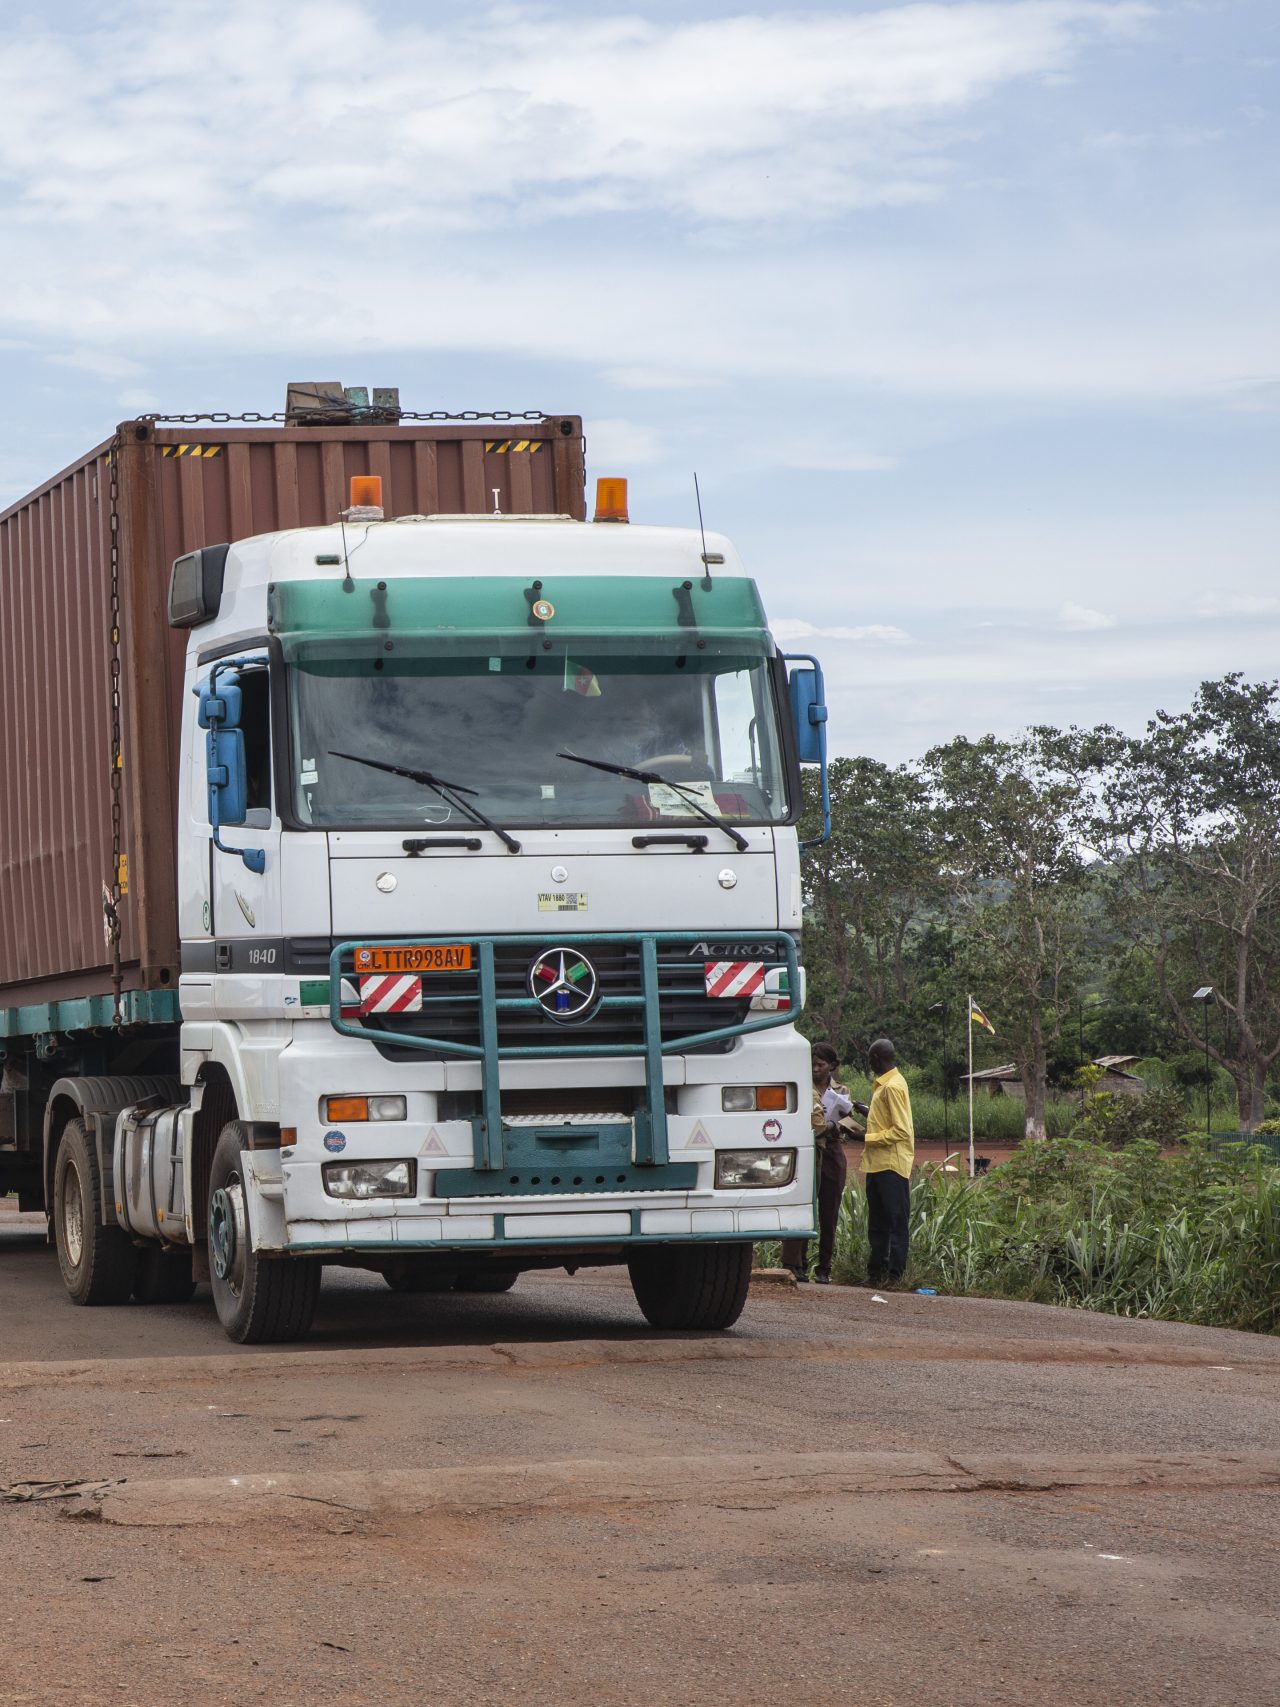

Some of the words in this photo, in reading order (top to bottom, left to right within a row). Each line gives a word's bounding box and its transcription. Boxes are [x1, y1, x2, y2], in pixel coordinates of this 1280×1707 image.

[249, 948, 276, 964] 1840
[688, 942, 777, 956] ACTROS
[372, 948, 464, 969] LTTR998AV
